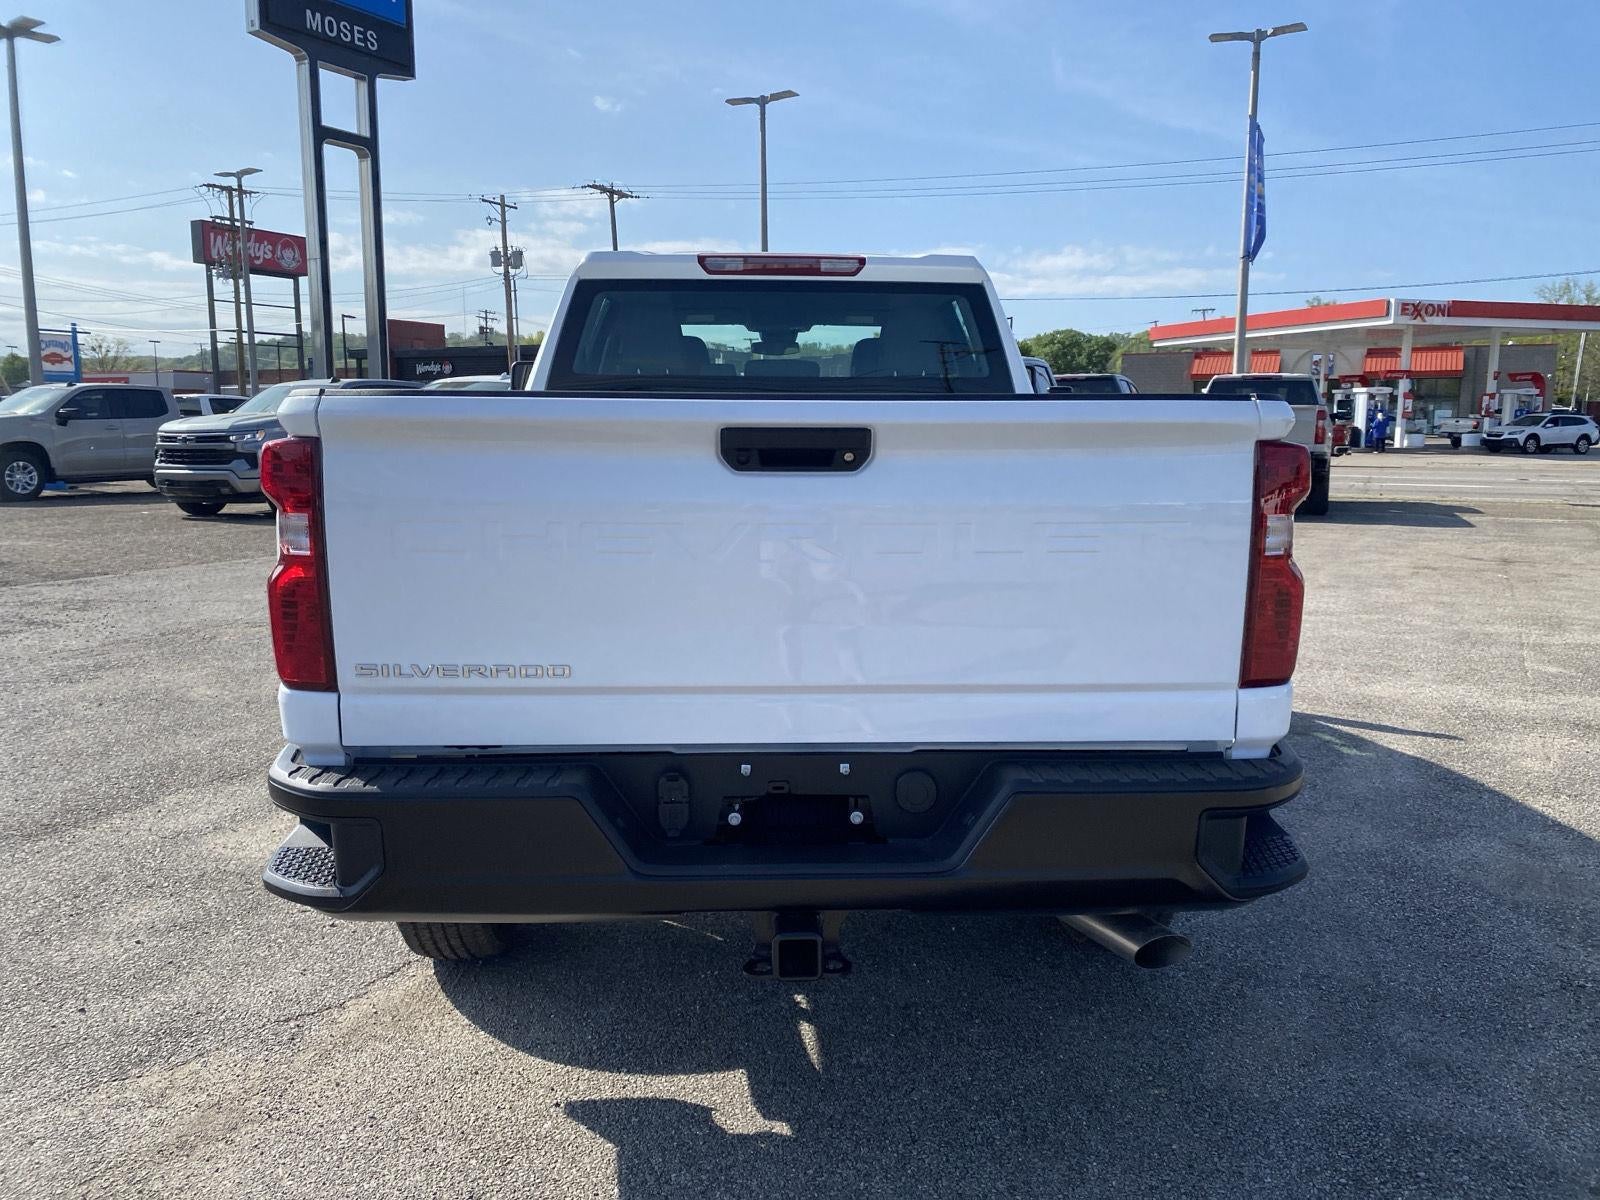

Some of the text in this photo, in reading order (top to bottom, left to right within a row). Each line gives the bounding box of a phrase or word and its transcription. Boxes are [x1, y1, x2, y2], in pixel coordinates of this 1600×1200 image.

[305, 9, 378, 51] MOSES
[1400, 300, 1447, 322] EXXON
[416, 361, 441, 375] Wendy's
[391, 519, 1192, 560] CHEVROLET
[355, 663, 572, 679] SILVERADO
